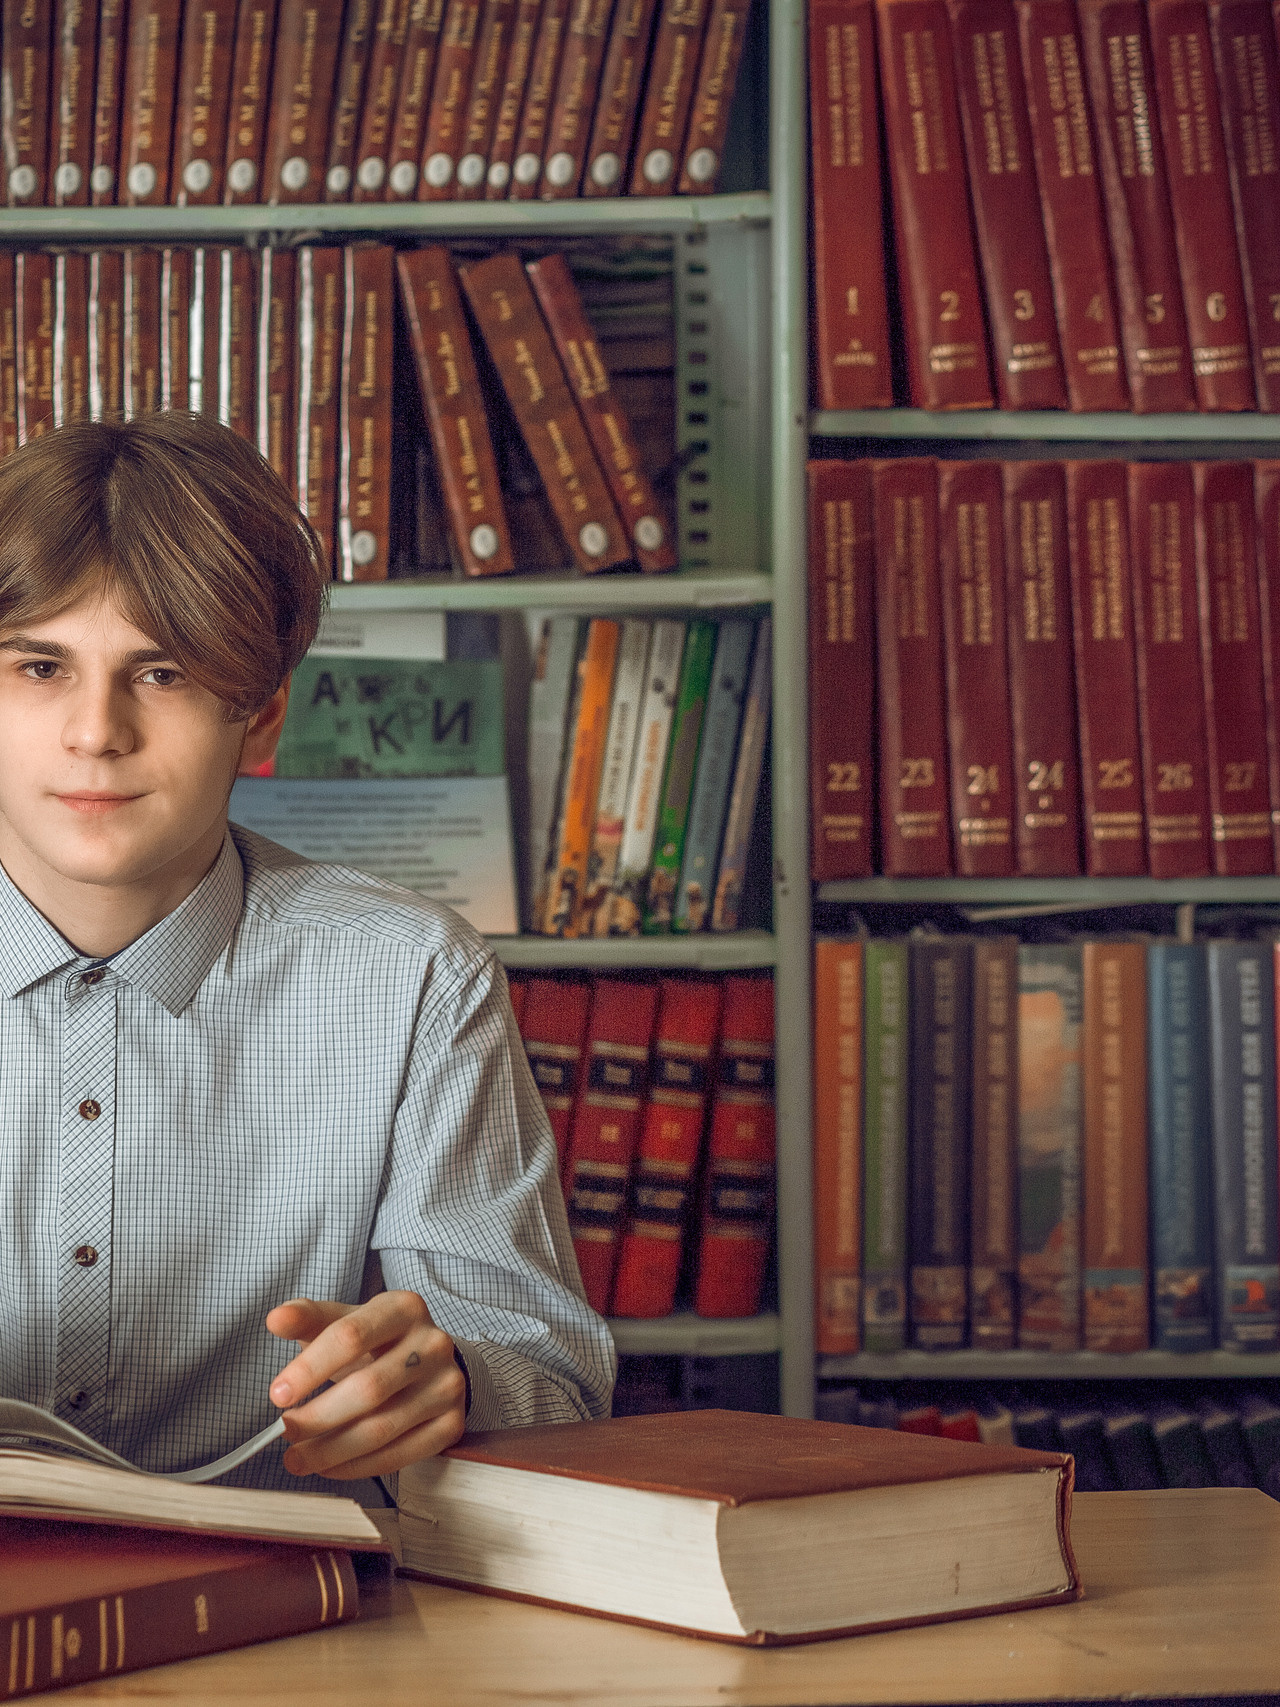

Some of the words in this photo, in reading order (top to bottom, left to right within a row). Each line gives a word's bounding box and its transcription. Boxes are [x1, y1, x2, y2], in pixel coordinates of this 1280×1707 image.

[847, 287, 858, 315] 1
[940, 291, 959, 321] 2
[1014, 290, 1035, 320] 3
[1085, 294, 1104, 322] 4
[1147, 295, 1165, 323] 5
[1206, 292, 1226, 321] 6
[369, 699, 477, 755] КРИ
[827, 763, 860, 790] 22
[900, 759, 935, 788] 23
[1098, 760, 1134, 788] 25
[1157, 763, 1193, 791] 26
[1225, 763, 1257, 790] 27
